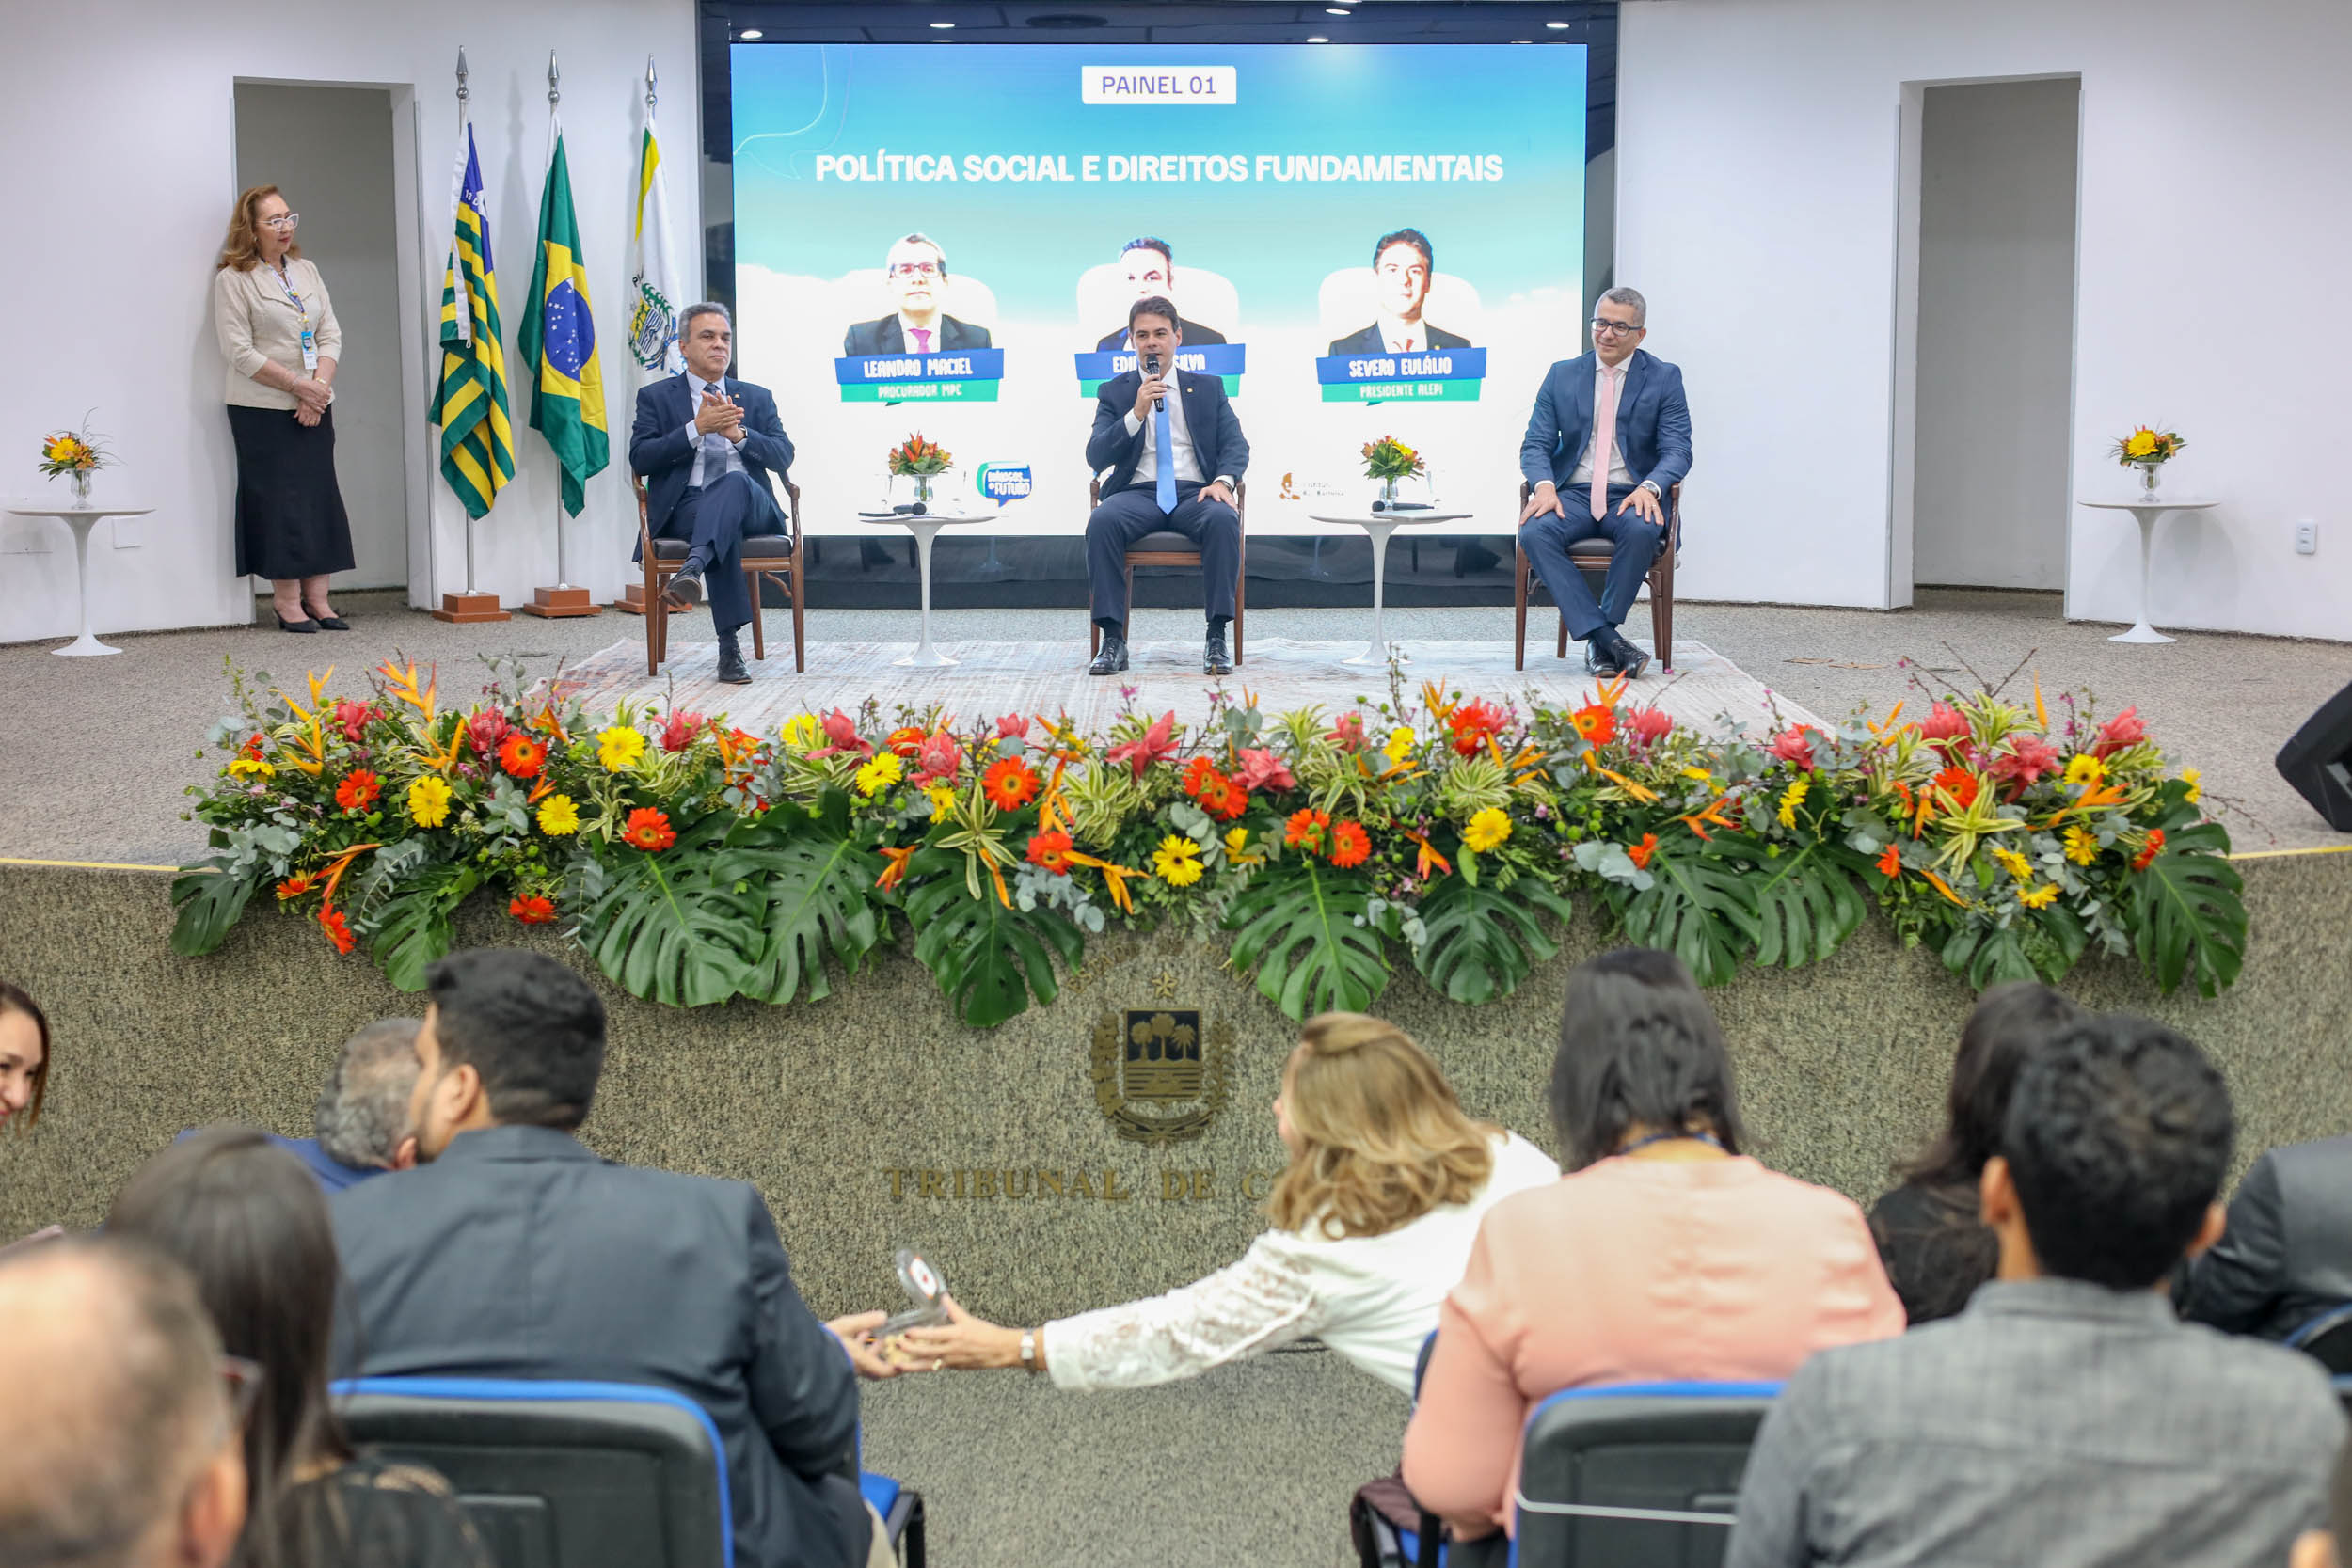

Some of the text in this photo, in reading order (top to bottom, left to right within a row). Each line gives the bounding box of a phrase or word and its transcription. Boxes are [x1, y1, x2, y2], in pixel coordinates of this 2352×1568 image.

[1102, 75, 1216, 95] PAINEL 01
[816, 148, 1504, 182] POLÍTICA SOCIAL E DIREITOS FUNDAMENTAIS
[864, 357, 974, 378] LEANDRO MACIEL
[1348, 354, 1453, 378] SEVERO EULÁLIO
[878, 383, 962, 399] PROCURADOR MPC
[1359, 383, 1444, 399] PRESIDENTE ALEPI
[883, 1166, 1131, 1201] TRIBUNAL
[1160, 1169, 1216, 1201] DE
